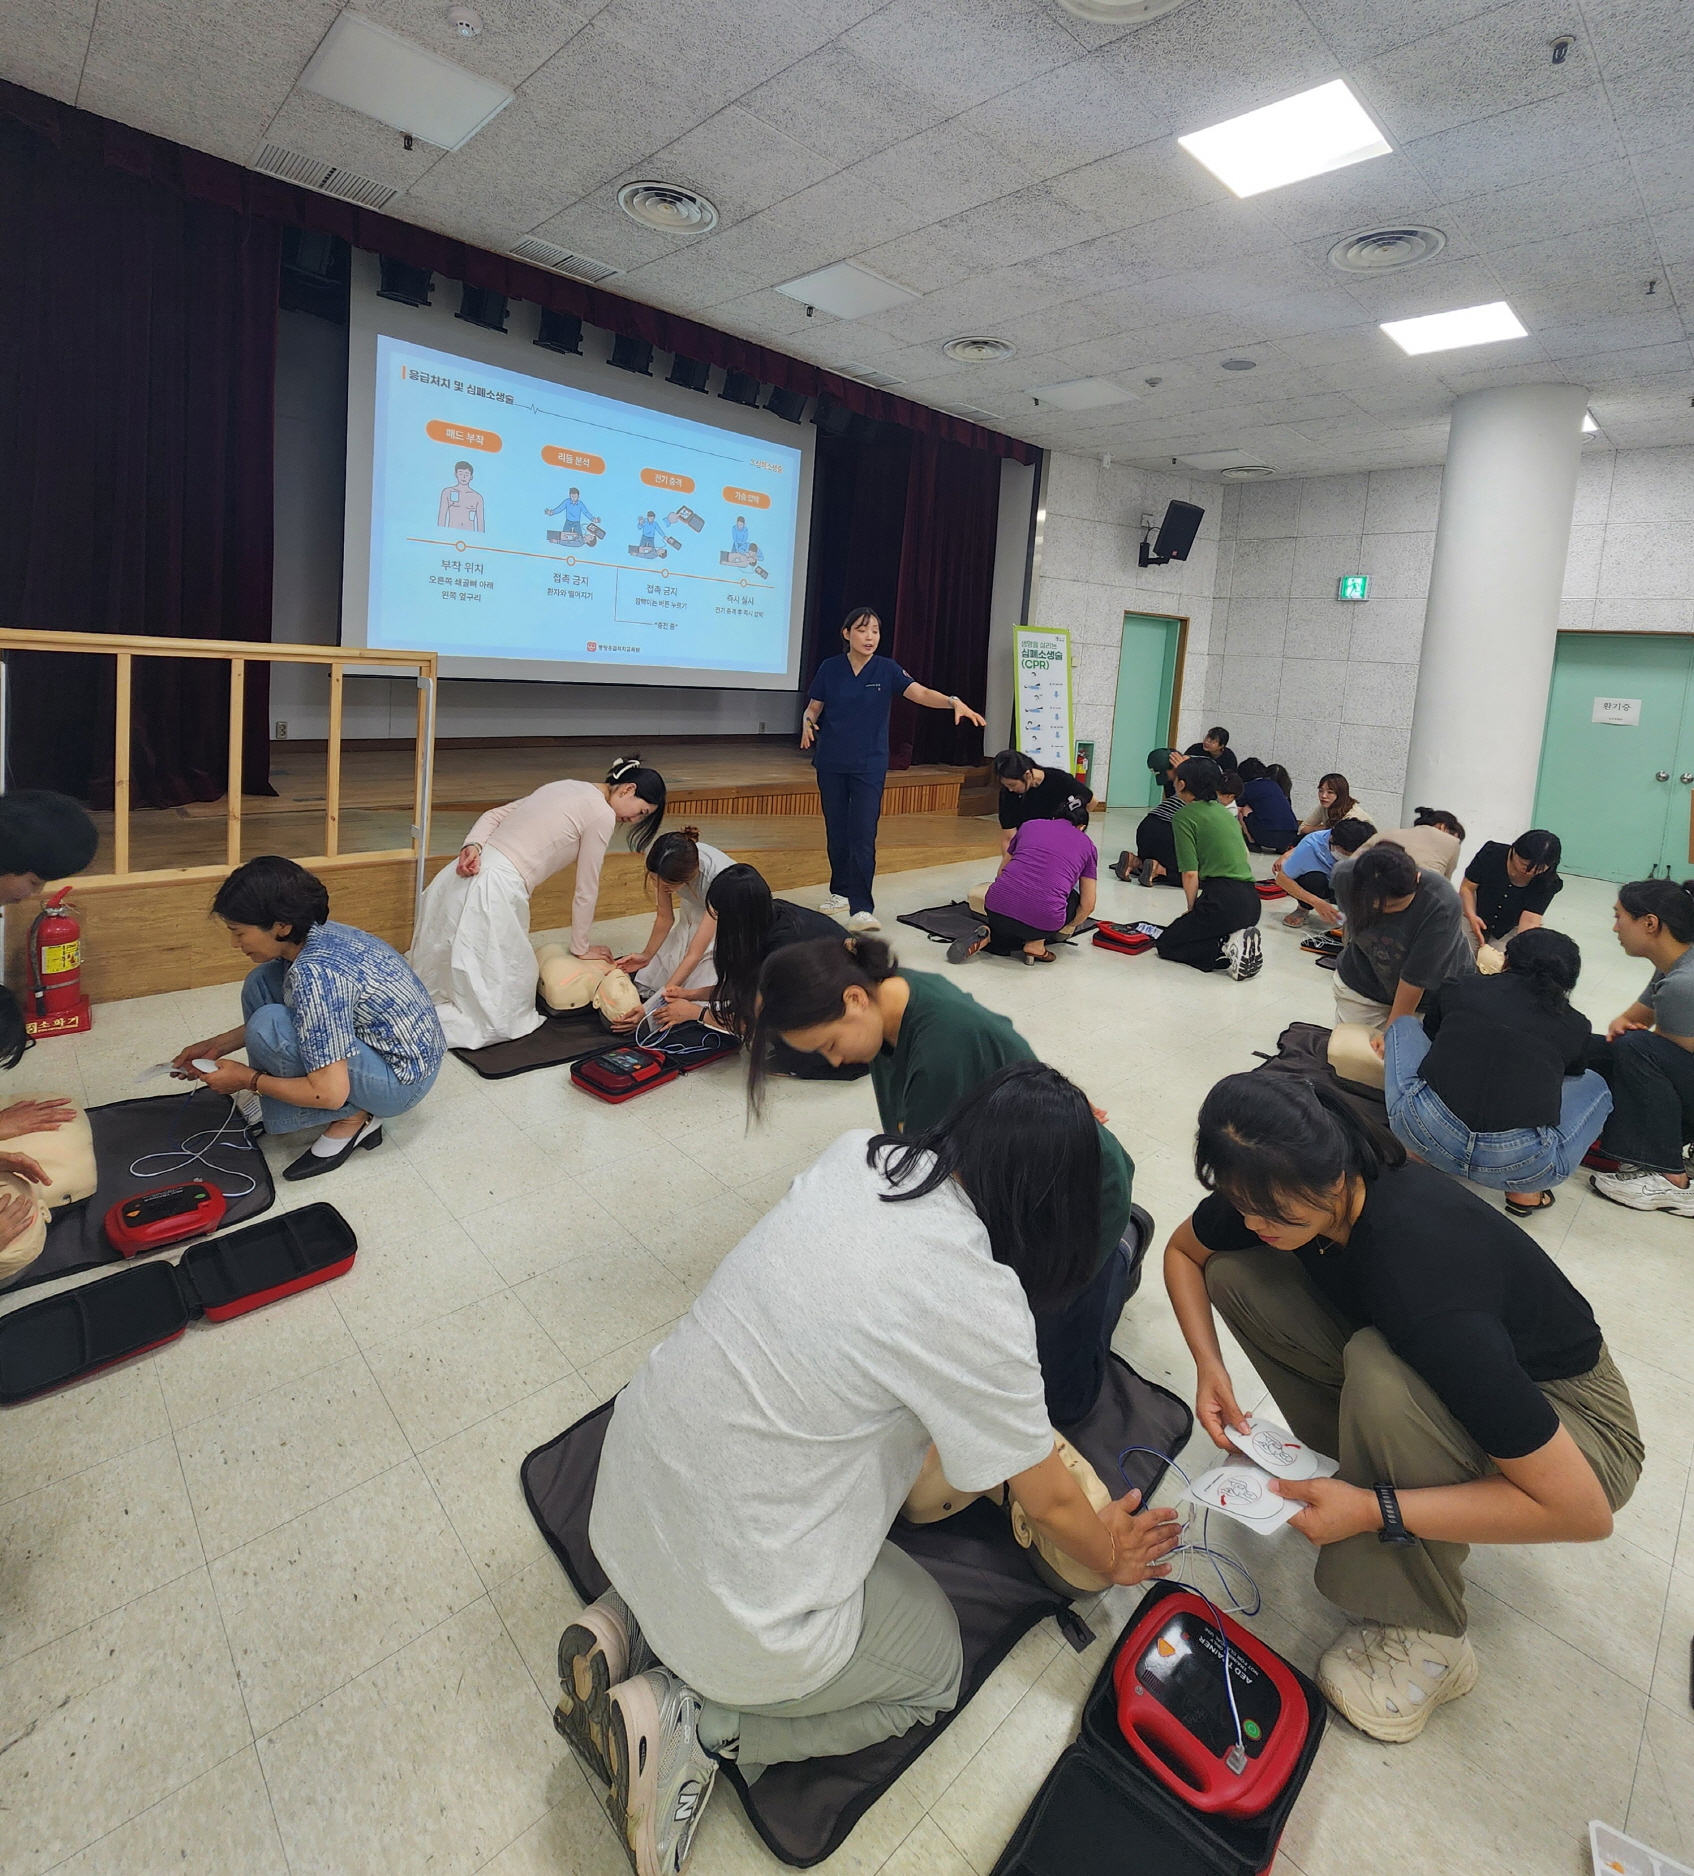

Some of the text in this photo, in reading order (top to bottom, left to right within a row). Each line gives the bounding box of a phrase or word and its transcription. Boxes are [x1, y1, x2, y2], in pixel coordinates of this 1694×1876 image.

[409, 369, 515, 405] 응급처치 및 심폐소생술
[446, 428, 484, 445] 패드 부착
[558, 452, 590, 468] 리듬 분석
[655, 473, 682, 487] 전기 충격
[735, 491, 760, 504] 가슴 압박
[441, 559, 484, 575] 부착 위치
[429, 575, 494, 590] 오른쪽 쇄골뼈 아래
[553, 572, 589, 587] 접촉 금지
[441, 590, 482, 602] 왼쪽 옆구리
[547, 587, 594, 600] 환자와 떨어지기
[646, 584, 678, 597] 접촉 금지
[658, 600, 670, 609] 버튼
[671, 601, 688, 610] 누르기
[727, 594, 754, 606] 즉시 실시
[1021, 640, 1058, 650] 생명을 살리는
[1021, 648, 1063, 660] 심폐소생술
[1021, 659, 1050, 671] (CPR)
[38, 1015, 79, 1029] 소화기
[1198, 1635, 1253, 1684] AED TAINER
[1247, 1665, 1259, 1676] NOT
